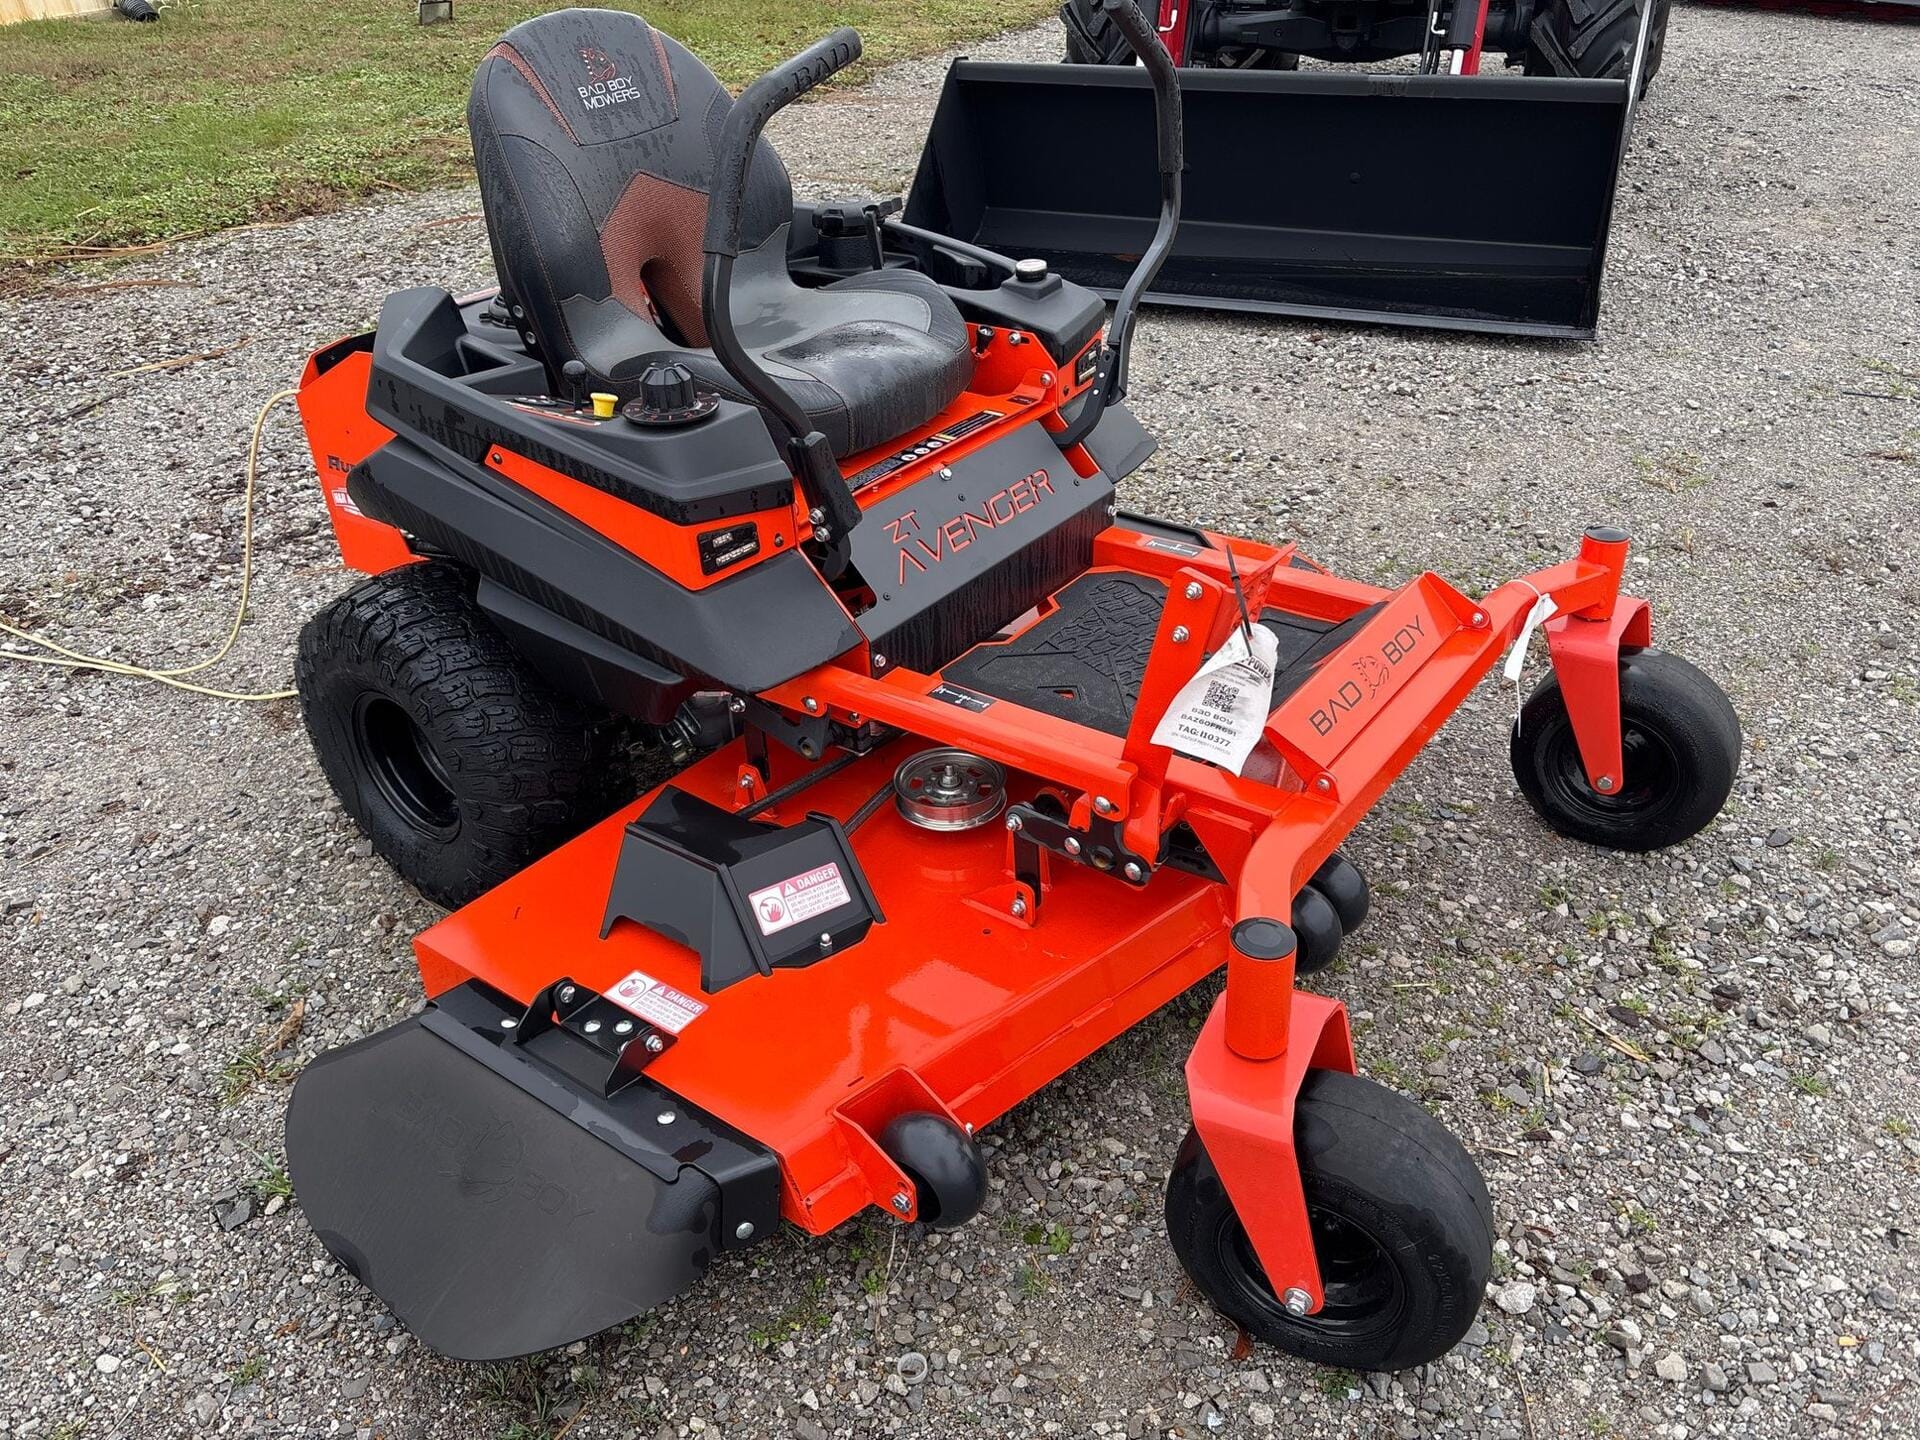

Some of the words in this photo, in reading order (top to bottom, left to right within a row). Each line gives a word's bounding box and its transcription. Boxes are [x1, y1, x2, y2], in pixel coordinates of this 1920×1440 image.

[792, 43, 849, 92] BAD
[578, 83, 606, 98] BAD
[607, 76, 633, 91] BOY
[583, 87, 640, 111] MOWERS
[883, 510, 921, 544] ZT
[899, 469, 1055, 585] AVENGER
[1309, 681, 1362, 736] BAD
[1382, 615, 1425, 665] BOY
[1178, 724, 1199, 736] TAG:
[797, 867, 836, 889] DANGER
[665, 991, 704, 1013] DANGER
